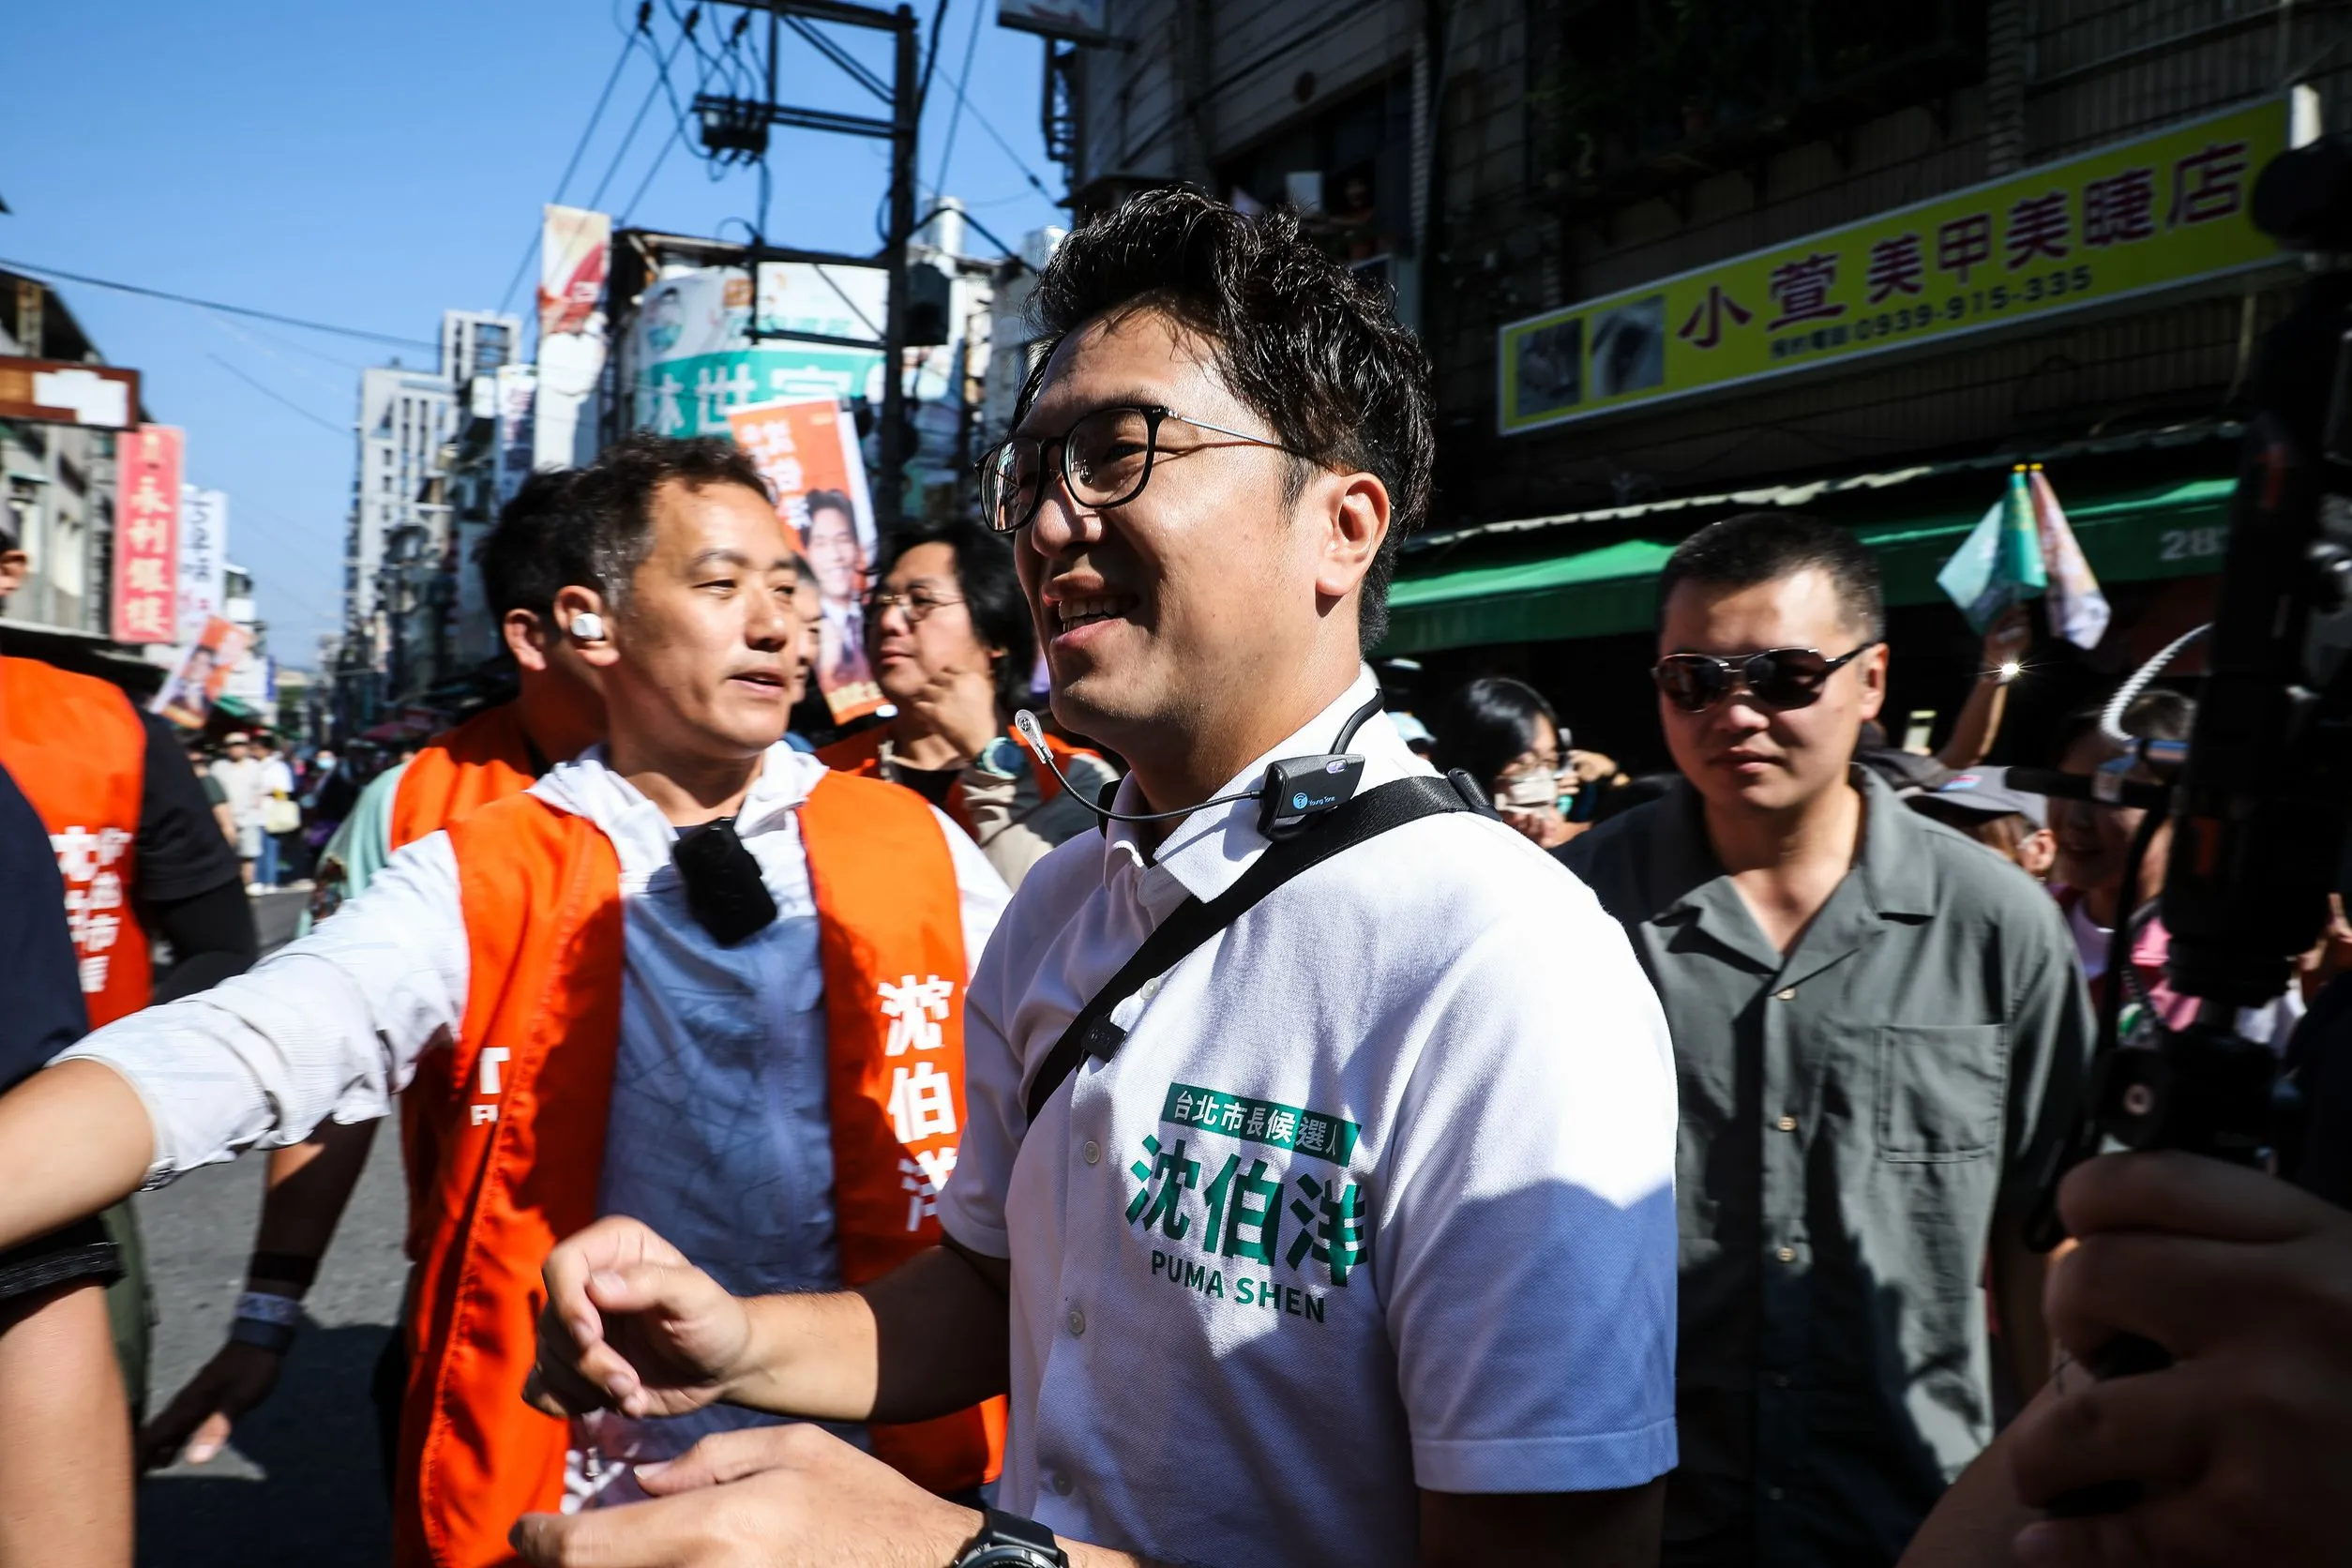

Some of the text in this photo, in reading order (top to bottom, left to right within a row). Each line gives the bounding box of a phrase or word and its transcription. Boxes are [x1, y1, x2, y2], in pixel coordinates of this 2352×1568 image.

[1679, 143, 2249, 347] 小萱美甲美睫店
[1855, 265, 2092, 342] 0939-915-335
[1174, 1090, 1336, 1156] 台北市長候選人
[1125, 1134, 1368, 1287] 沈伯洋
[1151, 1250, 1325, 1324] PUMA SHEN
